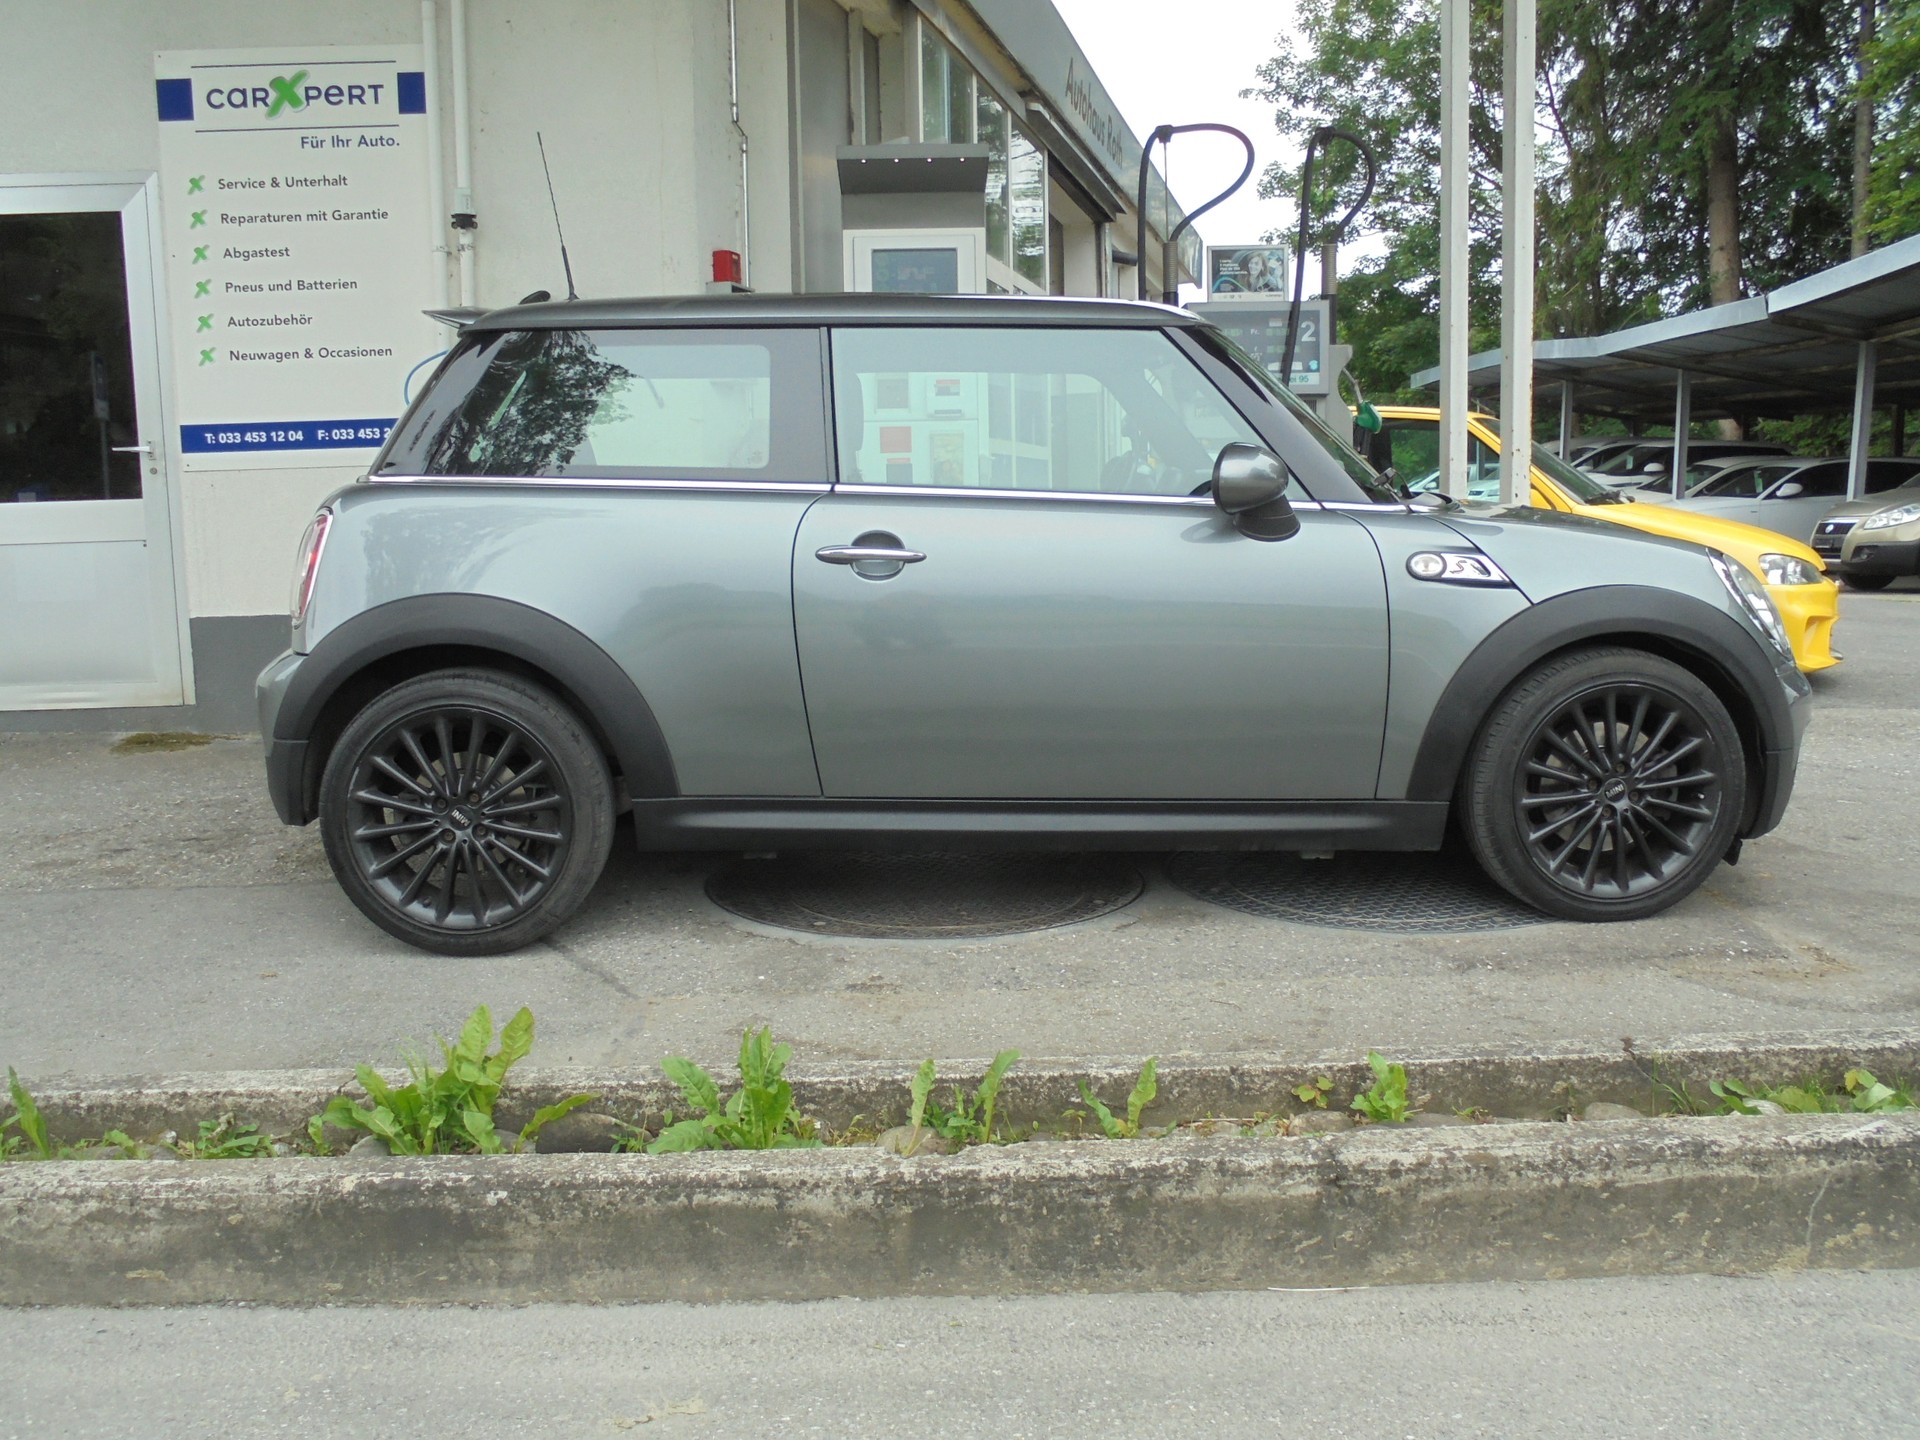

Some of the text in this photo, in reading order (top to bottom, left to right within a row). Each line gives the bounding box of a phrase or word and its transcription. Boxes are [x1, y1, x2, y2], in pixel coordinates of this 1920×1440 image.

[1065, 57, 1105, 147] Autohaus
[300, 134, 401, 149] Für Ihr Auto.
[218, 175, 348, 190] Service & Unterhalt
[220, 208, 389, 227] Reparaturen mit Garantie
[223, 247, 290, 262] Abgastest
[225, 279, 358, 293] Pneus und Batterien
[227, 314, 313, 328] Autozubehör
[1301, 321, 1317, 342] 2
[229, 346, 392, 363] Neuwagen & Occasionen
[204, 433, 216, 444] T:
[218, 432, 241, 444] 033
[244, 432, 267, 443] 453
[270, 431, 285, 442] 12
[288, 430, 303, 442] 04
[317, 430, 329, 441] F:
[332, 429, 354, 441] 033
[358, 428, 381, 439] 453
[1605, 783, 1625, 799] MINI
[451, 809, 471, 827] MINI
